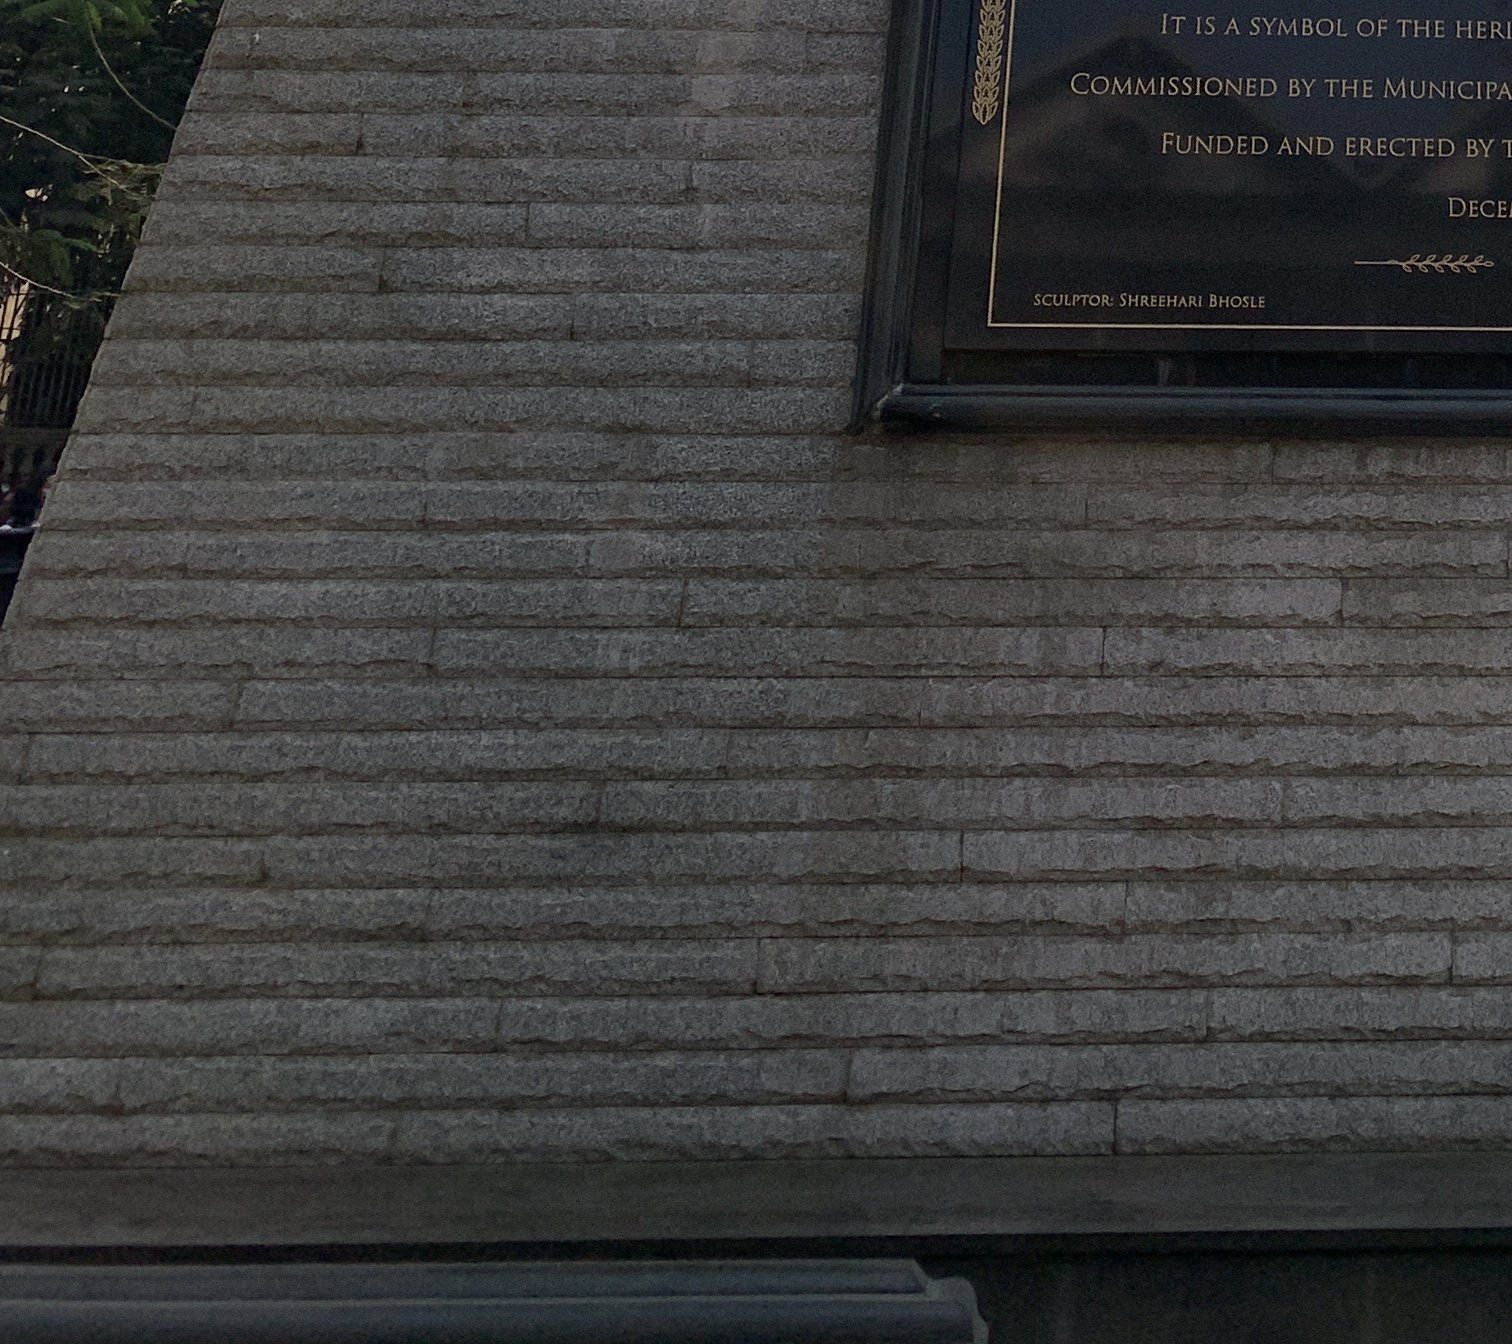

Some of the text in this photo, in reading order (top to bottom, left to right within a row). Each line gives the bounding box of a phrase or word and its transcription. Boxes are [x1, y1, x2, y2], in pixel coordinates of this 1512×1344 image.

[1160, 13, 1187, 35] IT
[1195, 16, 1216, 36] IS
[1223, 17, 1241, 36] A
[1249, 16, 1348, 38] SYMBOL
[1356, 17, 1388, 38] OF
[1395, 18, 1445, 38] THE
[1070, 72, 1278, 97] COMMISSIONED
[1288, 78, 1317, 98] BY
[1323, 78, 1374, 99] THE
[1161, 131, 1269, 155] FUNDED
[1276, 136, 1335, 156] AND
[1345, 136, 1456, 157] ERECTED
[1466, 137, 1495, 158] BY
[1033, 292, 1266, 309] SCULPTOR: SHREEHARI BHOSLE
